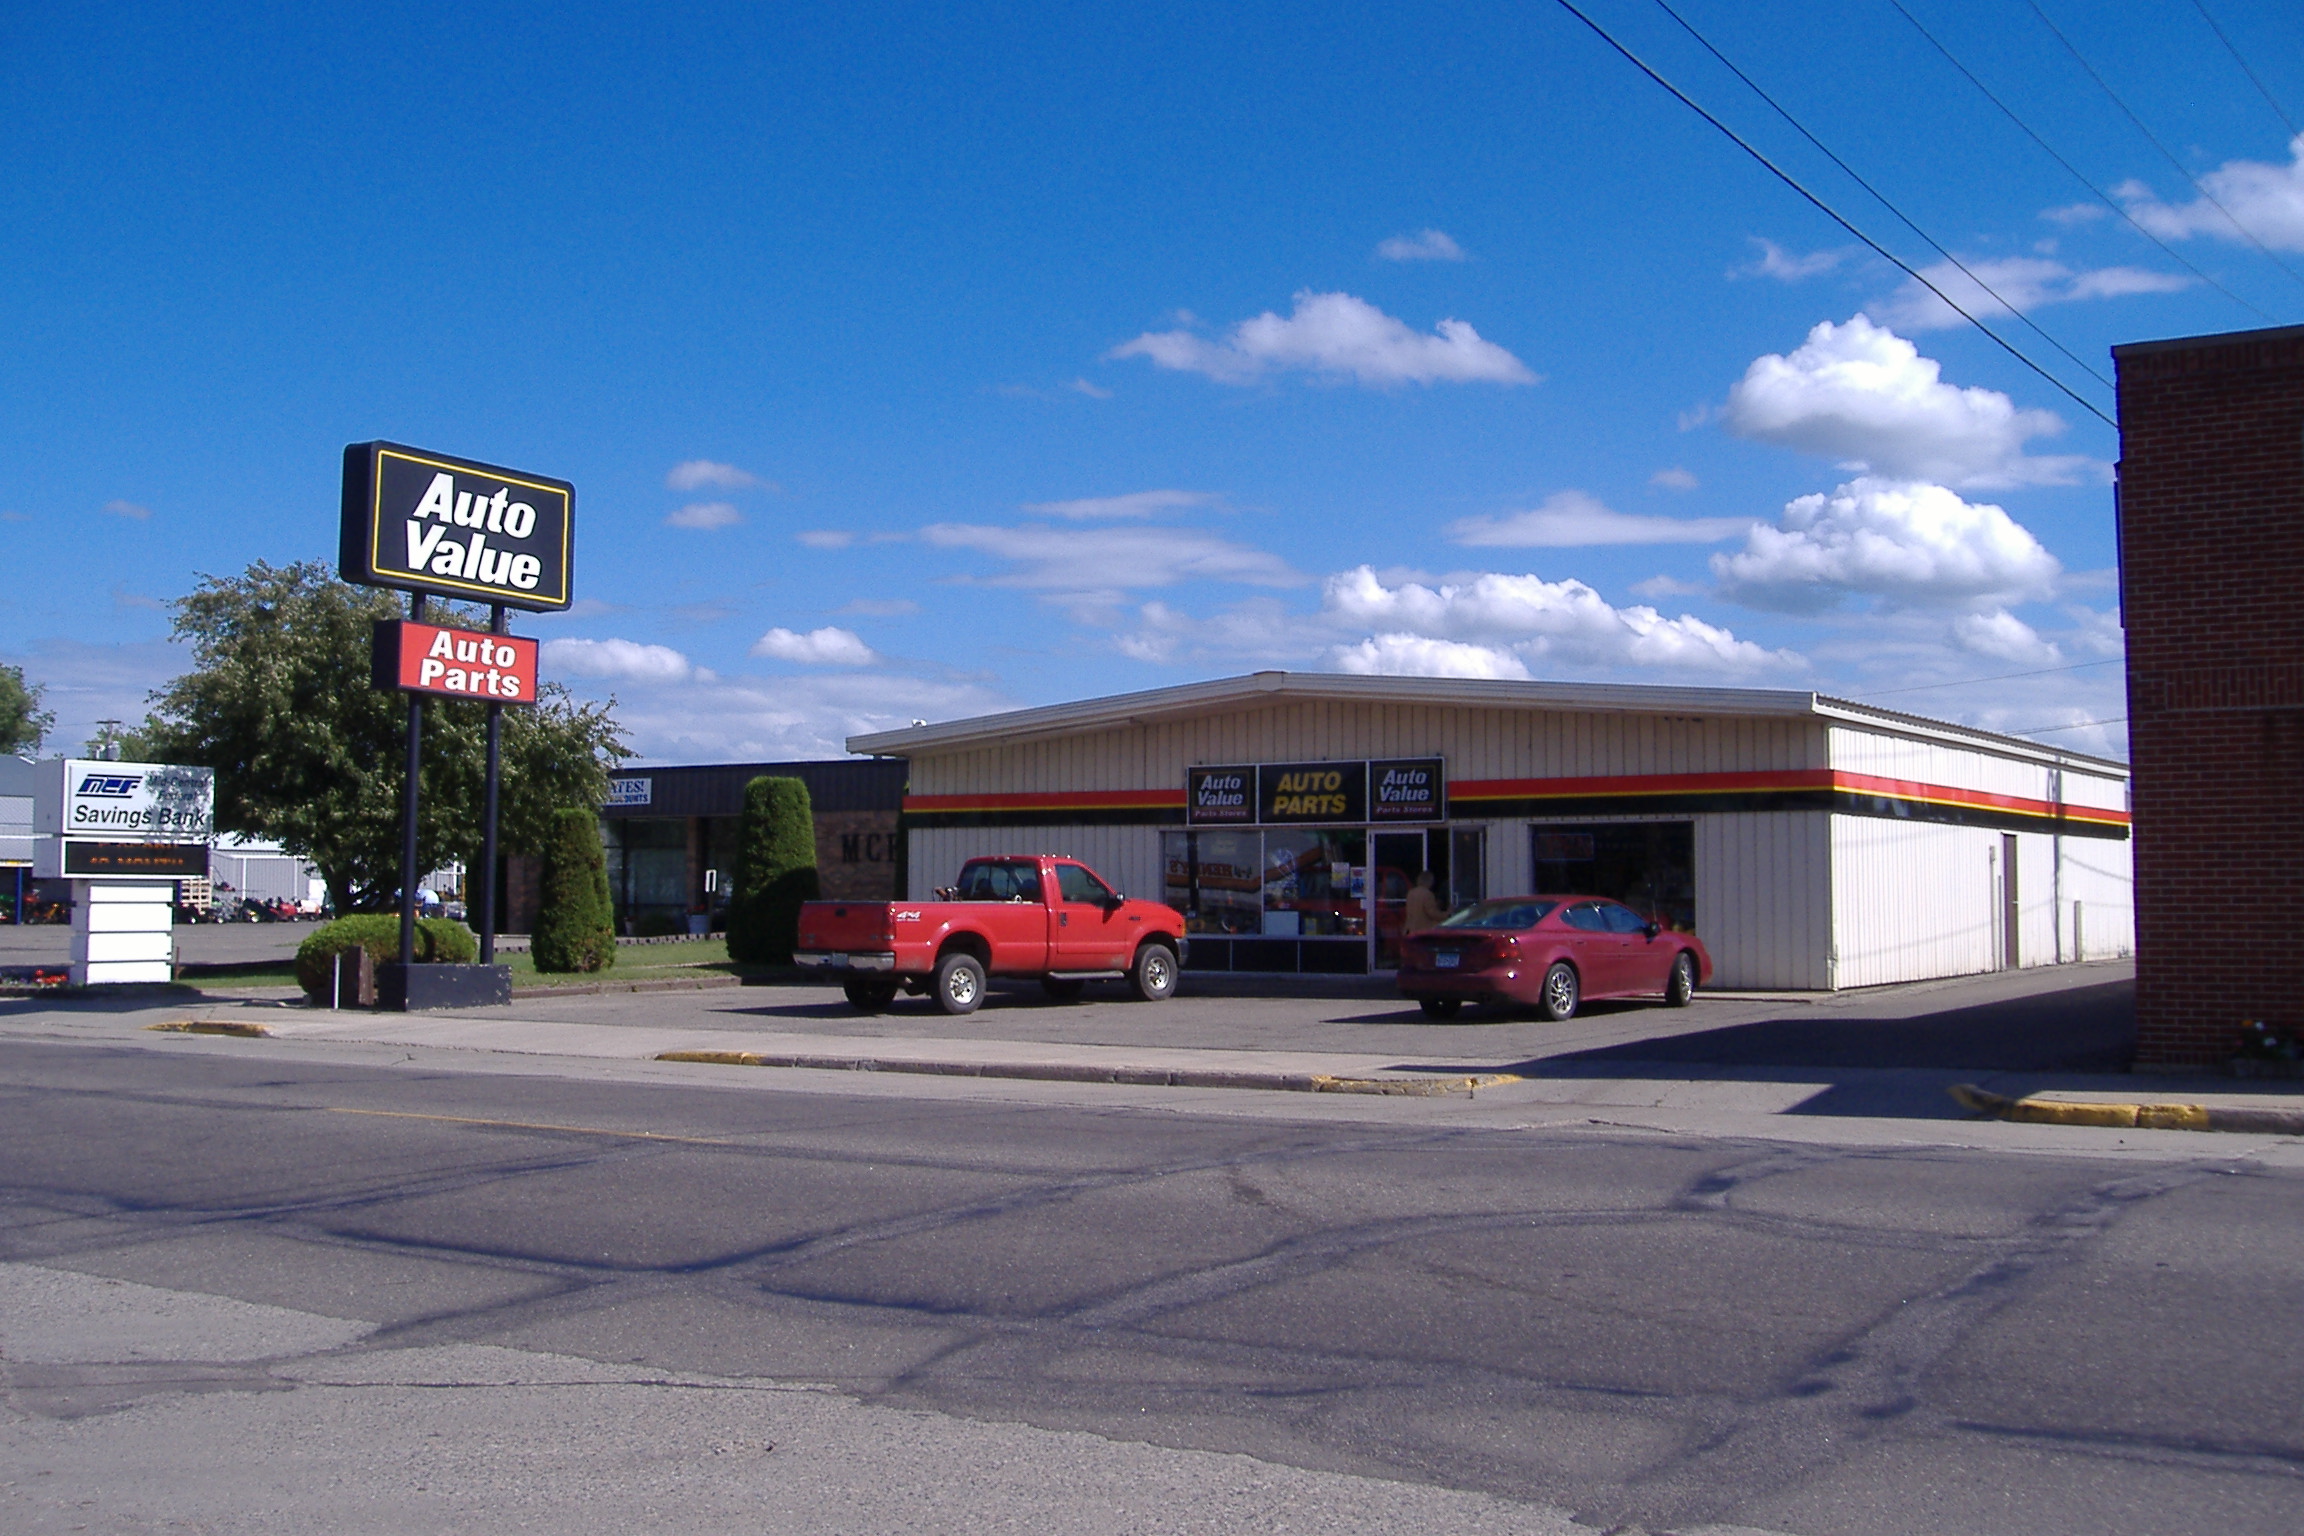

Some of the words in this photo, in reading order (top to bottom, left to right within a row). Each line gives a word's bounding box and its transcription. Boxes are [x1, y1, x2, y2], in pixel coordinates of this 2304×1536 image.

[413, 472, 537, 539] Auto
[406, 519, 542, 590] Value
[429, 630, 517, 668] Auto
[420, 658, 521, 698] Parts
[1200, 774, 1241, 790] Auto
[1277, 770, 1342, 793] AUTO
[1382, 768, 1428, 786] Auto
[1198, 790, 1244, 806] Value
[1272, 793, 1347, 815] PARTS
[1379, 786, 1430, 802] Value
[74, 805, 152, 828] Savings
[158, 808, 206, 826] Bank
